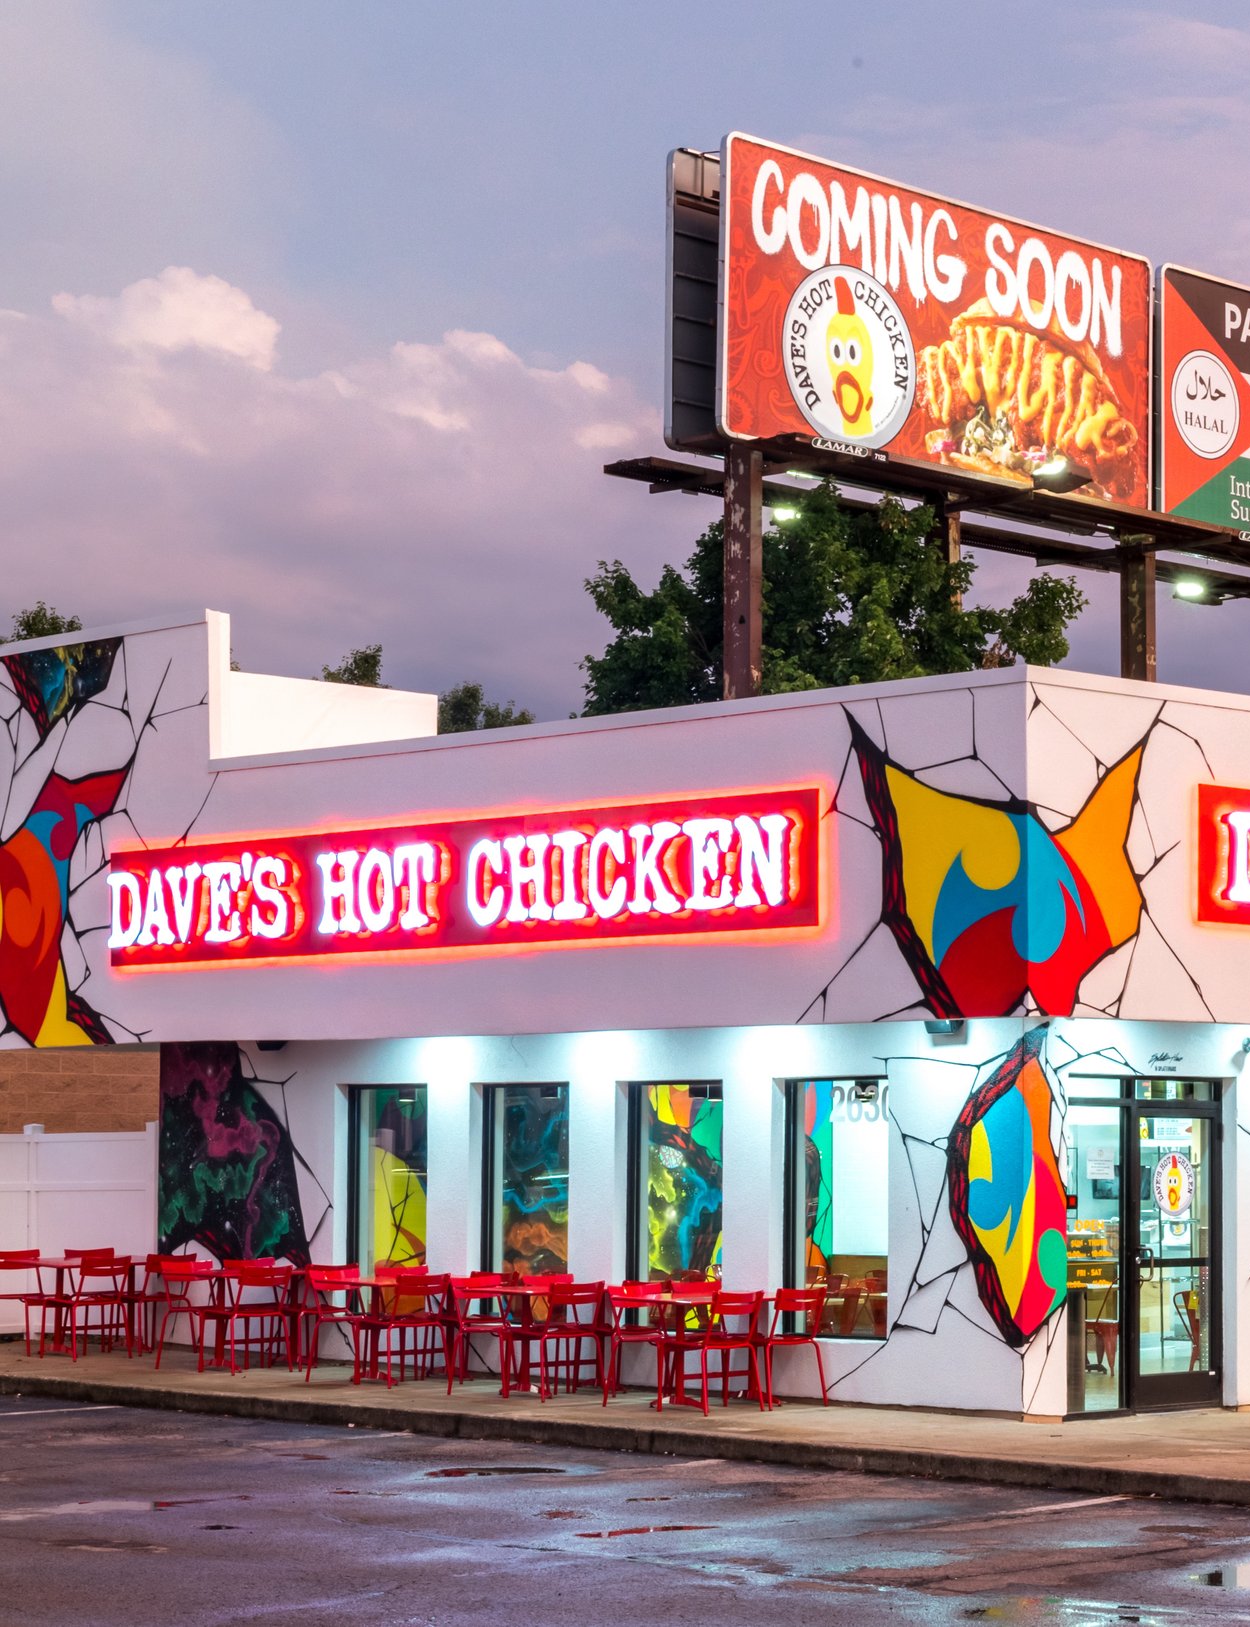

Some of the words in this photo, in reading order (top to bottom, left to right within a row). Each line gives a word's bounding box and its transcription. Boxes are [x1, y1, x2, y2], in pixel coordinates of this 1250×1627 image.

[752, 159, 967, 306] COMING
[985, 223, 1123, 357] SOON
[798, 279, 833, 321] HOT
[854, 281, 909, 392] CHICKEN
[791, 320, 821, 411] DAVE'S
[1185, 369, 1226, 401] حلال
[1184, 410, 1228, 435] HALAL
[816, 438, 863, 456] LAMAR
[107, 851, 290, 949] DAVE'S
[317, 842, 437, 935] HOT
[466, 814, 793, 928] CHICKEN
[1160, 1156, 1172, 1171] HOT
[1177, 1155, 1195, 1195] CHICKEN
[1074, 1219, 1105, 1232] OPEN
[1090, 1268, 1102, 1277] SAT
